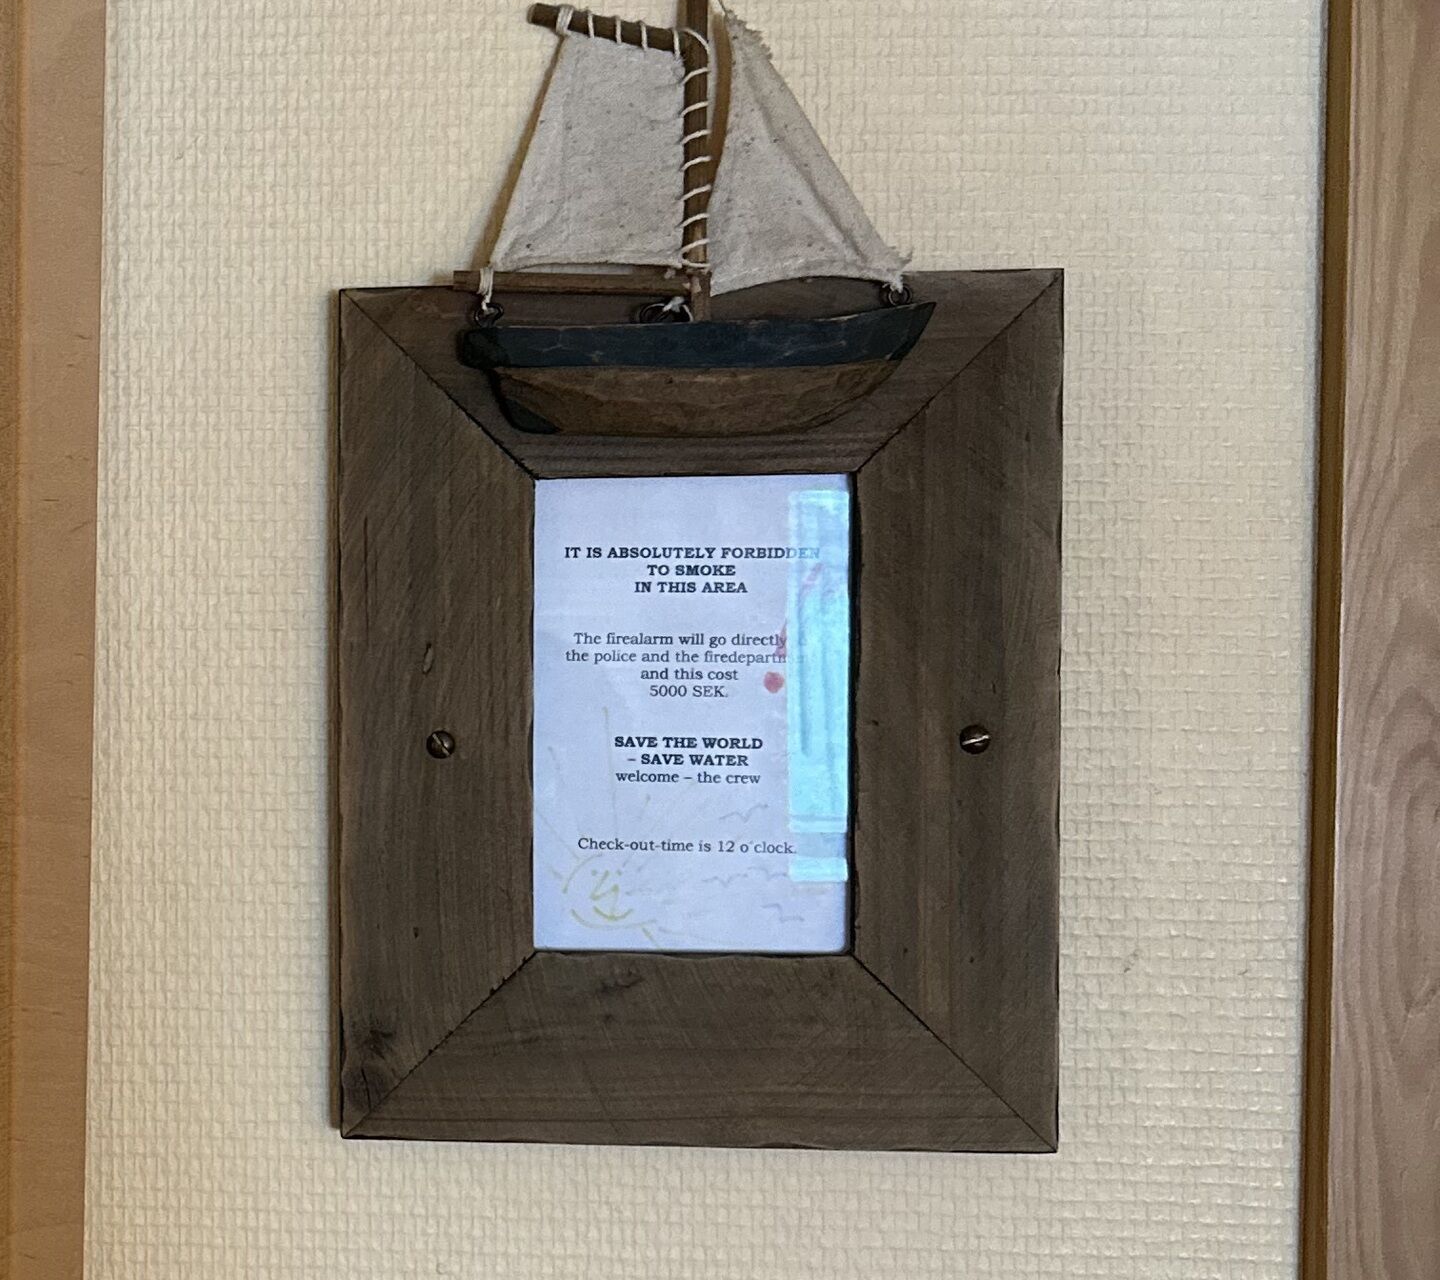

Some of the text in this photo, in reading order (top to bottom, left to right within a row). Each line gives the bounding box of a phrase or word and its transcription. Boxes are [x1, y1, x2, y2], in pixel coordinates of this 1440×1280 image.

[565, 547, 820, 559] IT IS ABSOLUTELY FORBIDDEN
[647, 565, 736, 576] TO SMOKE
[635, 582, 748, 593] IN THIS AREA
[574, 633, 786, 649] The firealarm will go directly
[566, 650, 589, 661] the
[594, 651, 636, 665] police
[642, 651, 669, 662] and
[676, 652, 699, 663] the
[640, 668, 738, 680] and this cost
[650, 685, 729, 697] 5000 SEK.
[615, 737, 763, 749] SAVE THE WORLD
[641, 754, 684, 765] SAVE
[689, 755, 748, 766] WATER
[616, 772, 679, 783] welcome
[697, 772, 721, 784] the
[726, 775, 760, 784] crew
[578, 838, 694, 852] Check-out-time
[699, 840, 711, 852] is
[718, 841, 735, 852] 12
